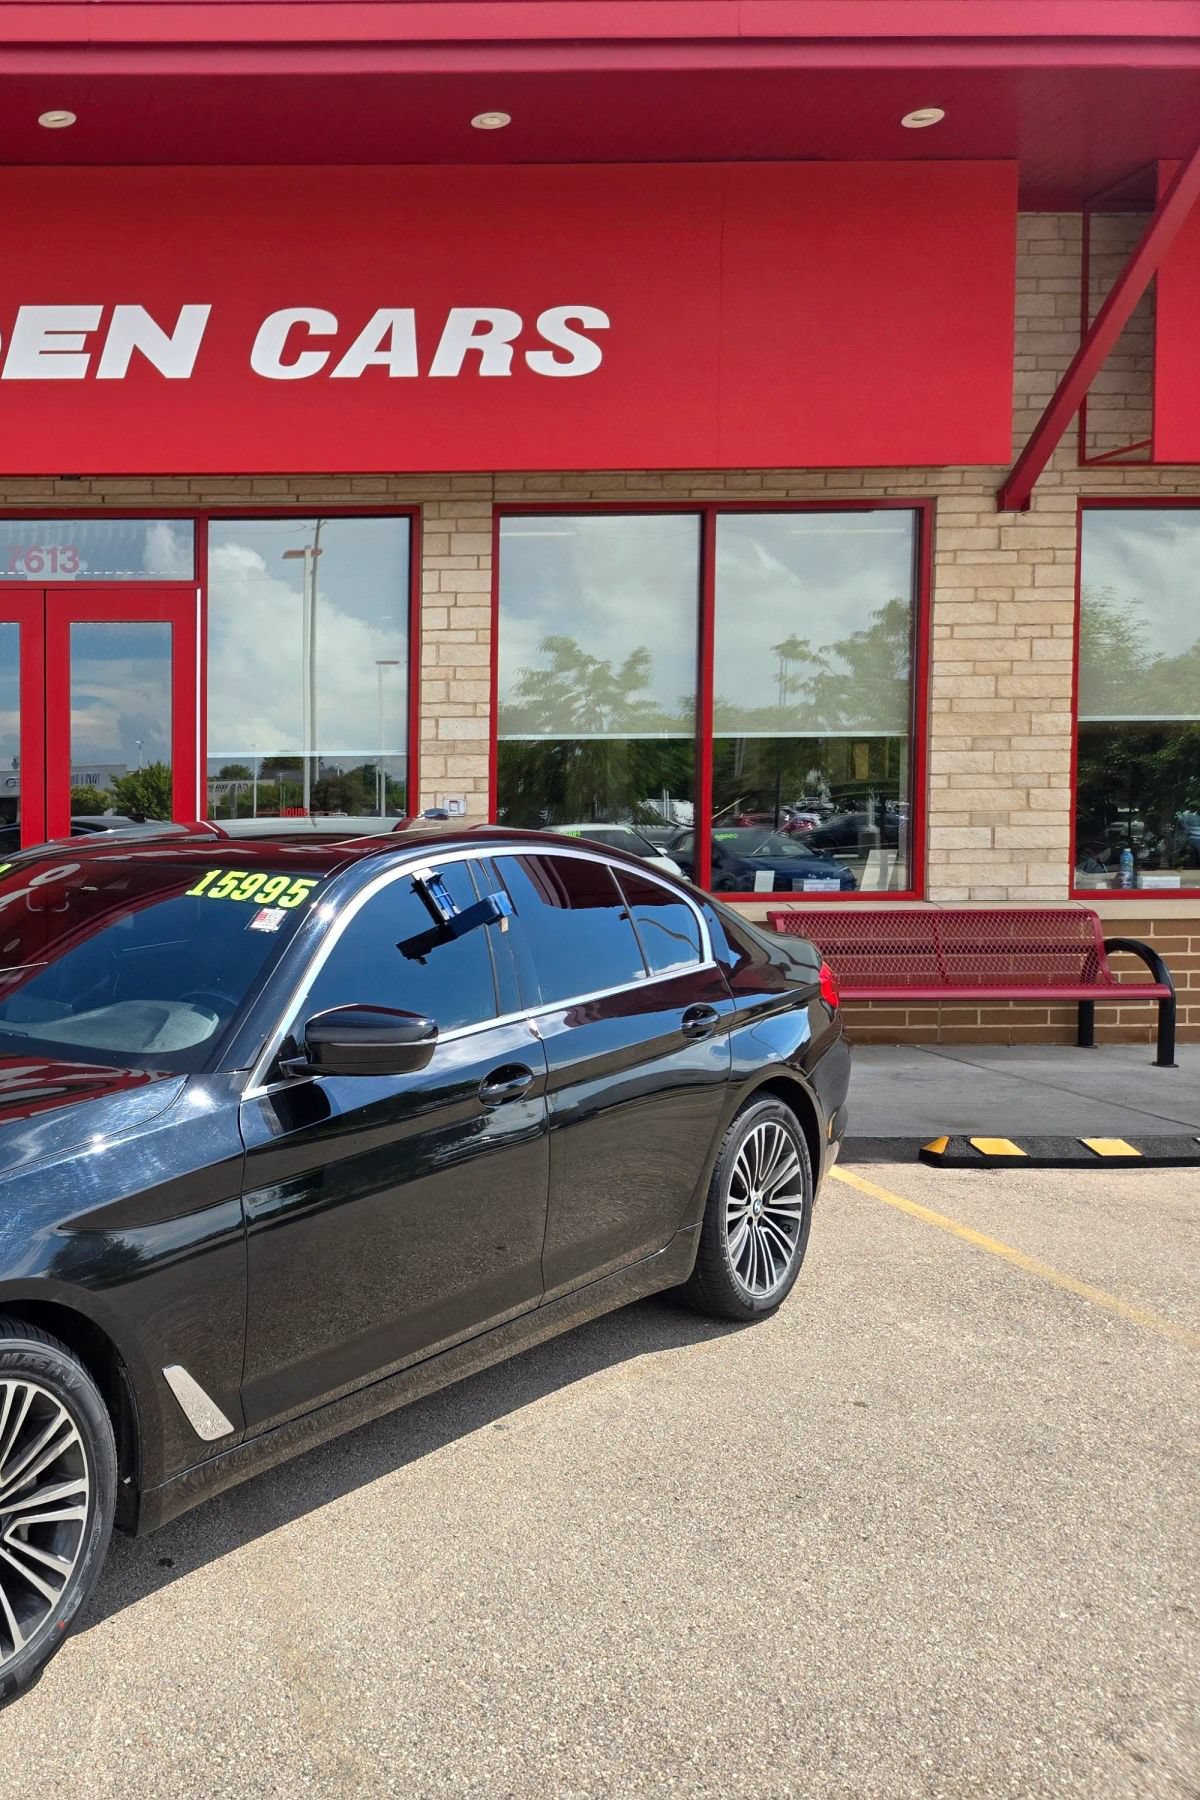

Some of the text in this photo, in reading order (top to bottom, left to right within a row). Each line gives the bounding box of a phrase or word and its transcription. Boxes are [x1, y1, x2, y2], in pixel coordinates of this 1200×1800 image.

[250, 305, 611, 379] CARS
[6, 544, 80, 574] 7613
[185, 869, 319, 908] 15995
